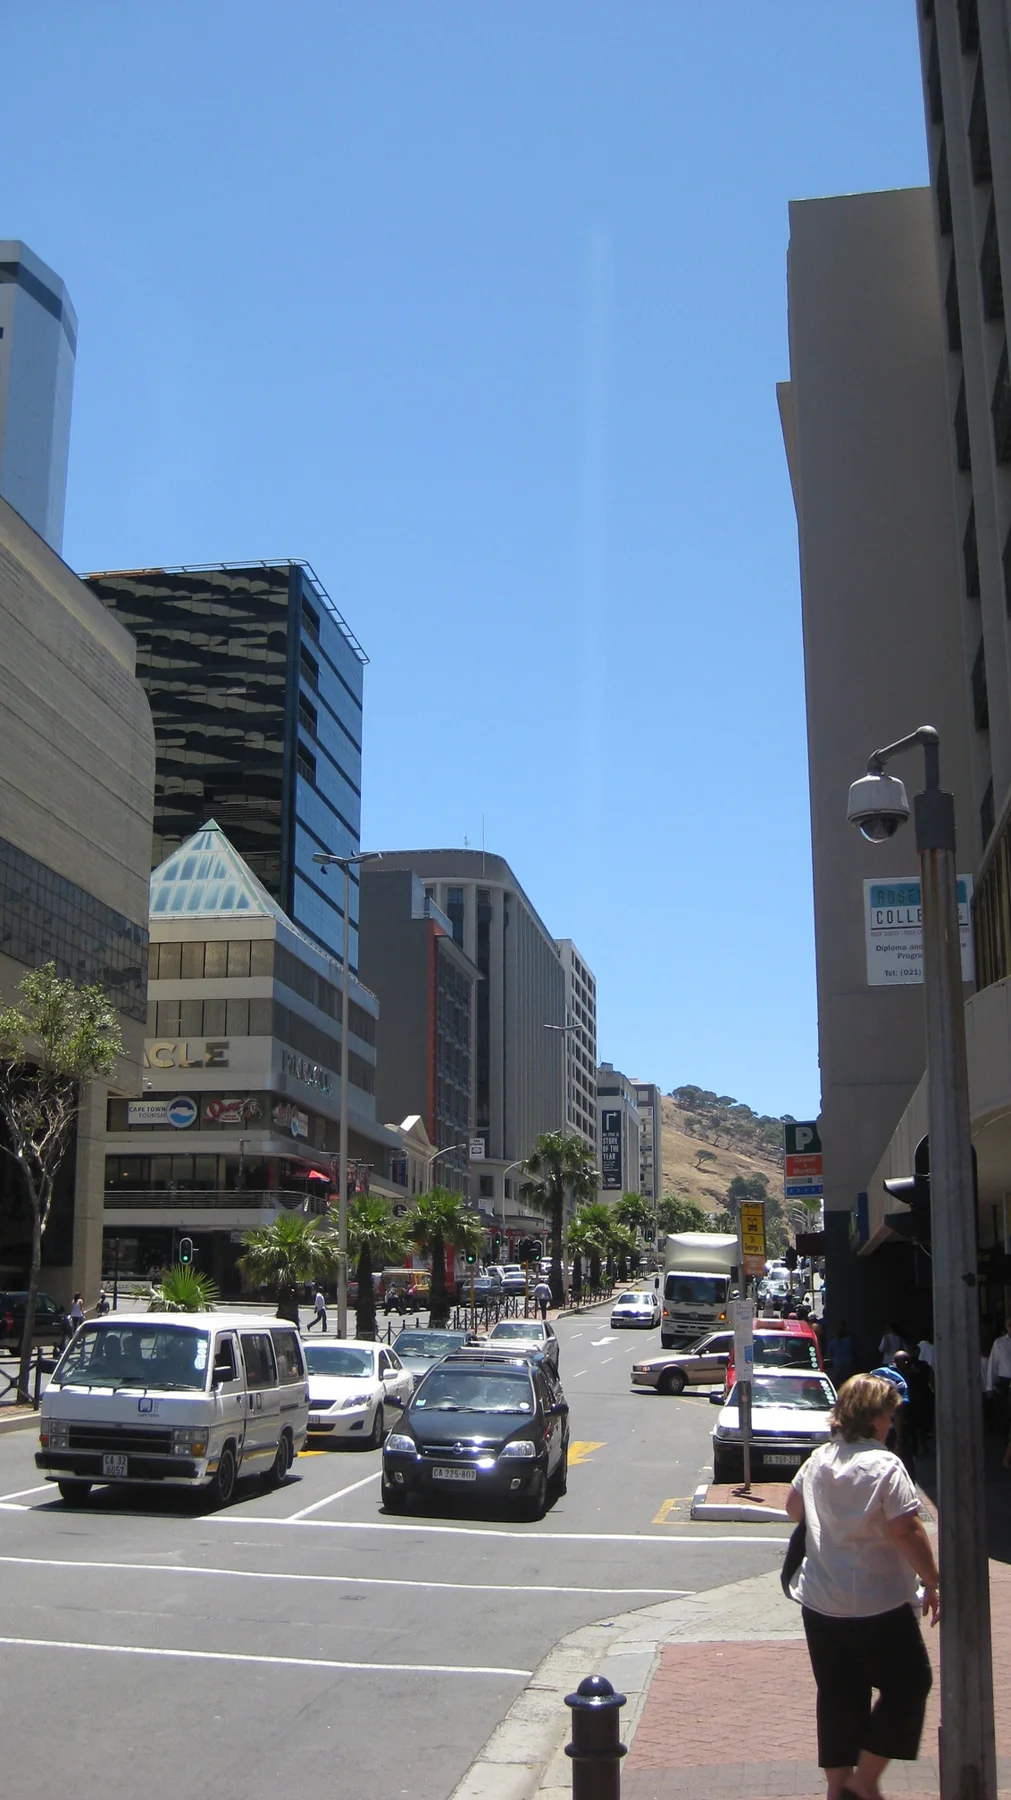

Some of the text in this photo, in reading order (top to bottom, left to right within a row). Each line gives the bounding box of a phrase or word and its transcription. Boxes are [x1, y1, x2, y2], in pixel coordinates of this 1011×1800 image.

[876, 944, 907, 953] Diploma
[900, 968, 922, 977] (021)
[602, 1137, 618, 1145] STORE
[795, 1126, 814, 1151] P
[602, 1145, 619, 1153] OF THE
[603, 1153, 616, 1161] YEAR
[104, 1455, 115, 1465] CA
[434, 1468, 443, 1478] CA
